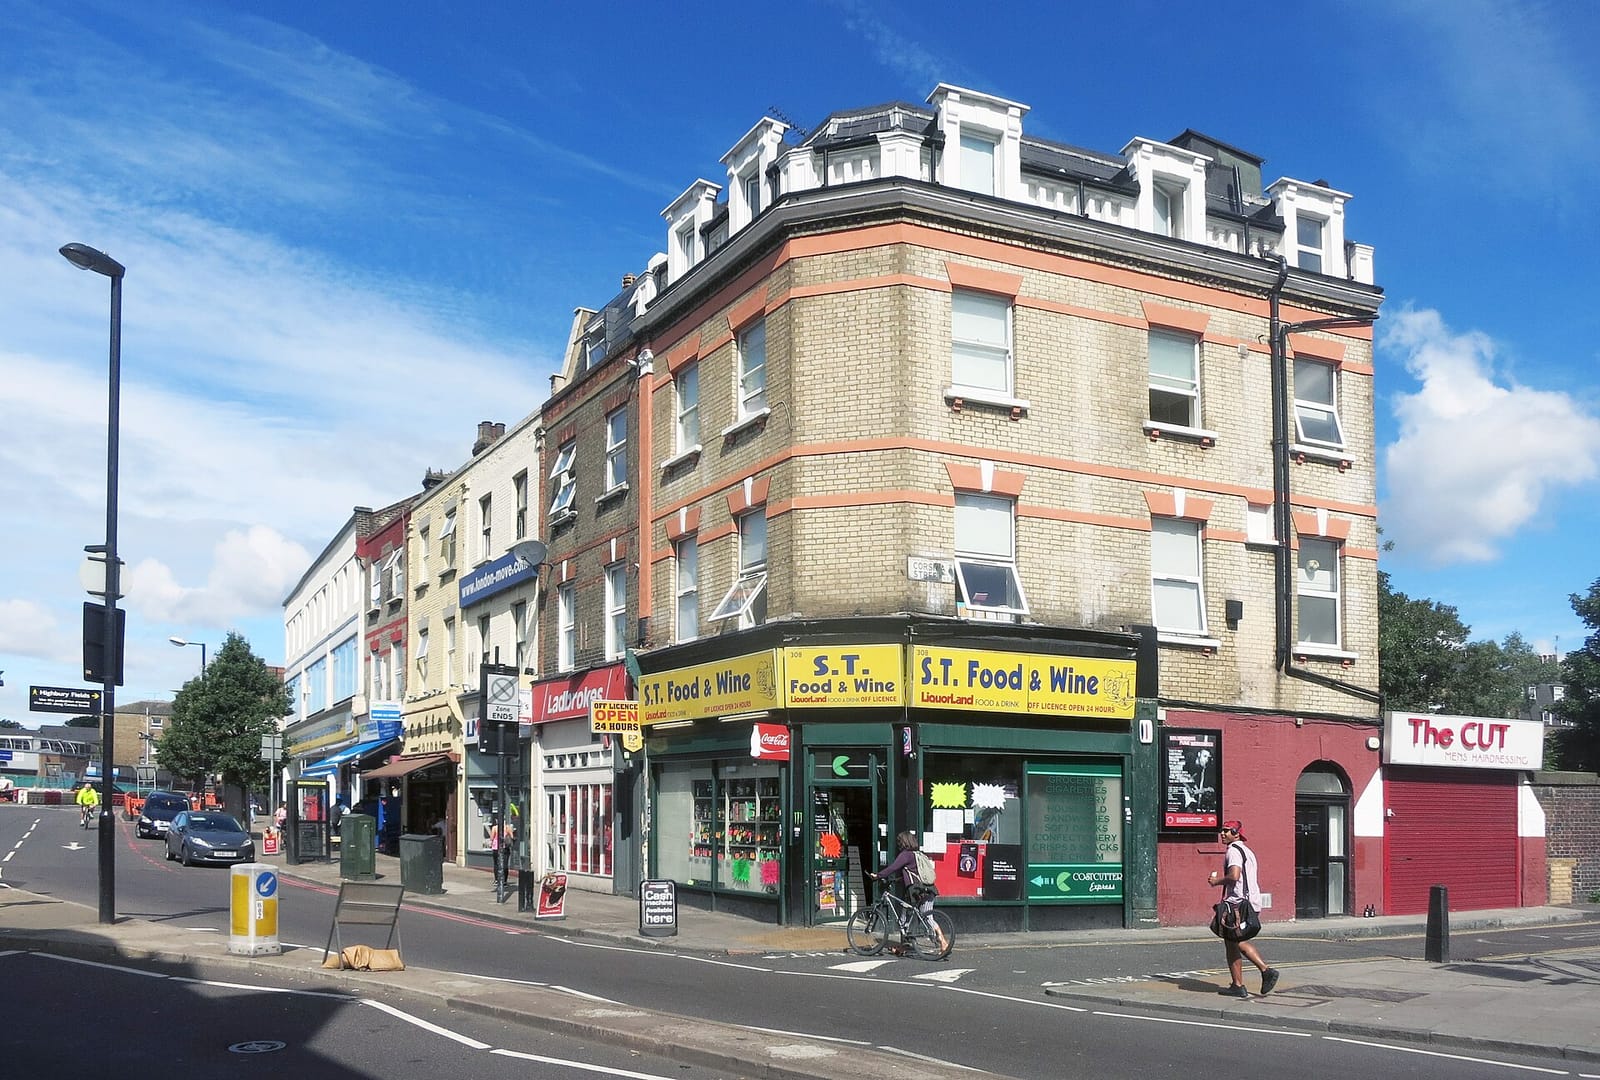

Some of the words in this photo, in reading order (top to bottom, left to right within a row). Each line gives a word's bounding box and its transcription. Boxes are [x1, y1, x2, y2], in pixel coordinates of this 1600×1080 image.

[913, 561, 946, 571] CORSA
[913, 570, 942, 579] STREE
[813, 655, 870, 676] S.T.
[921, 656, 958, 687] S.T.
[967, 660, 1023, 690] Food
[1029, 669, 1042, 691] &
[1050, 665, 1099, 695] Wine
[644, 682, 663, 706] S.T.
[667, 676, 700, 702] Food
[703, 678, 712, 697] &
[716, 669, 751, 695] Wine
[790, 679, 832, 694] Food
[838, 681, 848, 692] &
[854, 678, 895, 693] Wine
[40, 689, 69, 698] Highbury
[70, 691, 90, 699] Fields
[873, 695, 897, 703] LICENCE
[547, 686, 604, 714] Ladbrokes
[495, 705, 511, 713] Zone
[594, 702, 607, 710] OFF
[609, 702, 639, 710] LICENCE
[1001, 700, 1020, 708] DRINK
[1041, 702, 1067, 711] LICENCE
[1086, 704, 1094, 712] 24
[1095, 705, 1116, 713] HOURS
[492, 712, 514, 720] ENDS
[594, 710, 639, 722] OPEN
[410, 714, 452, 739] coffee
[594, 722, 607, 731] 24
[609, 722, 639, 731] HOURS
[1408, 718, 1454, 748] The
[1460, 722, 1511, 751] CUT
[1444, 751, 1468, 761] MENS
[1471, 753, 1529, 765] HAIRDRESSING
[1044, 815, 1111, 823] SANDWHES
[1034, 833, 1118, 842] CONFECTERY
[1072, 872, 1123, 880] COSTCUTTER
[1089, 881, 1116, 892] Express
[645, 889, 673, 900] Cash
[645, 912, 673, 923] here
